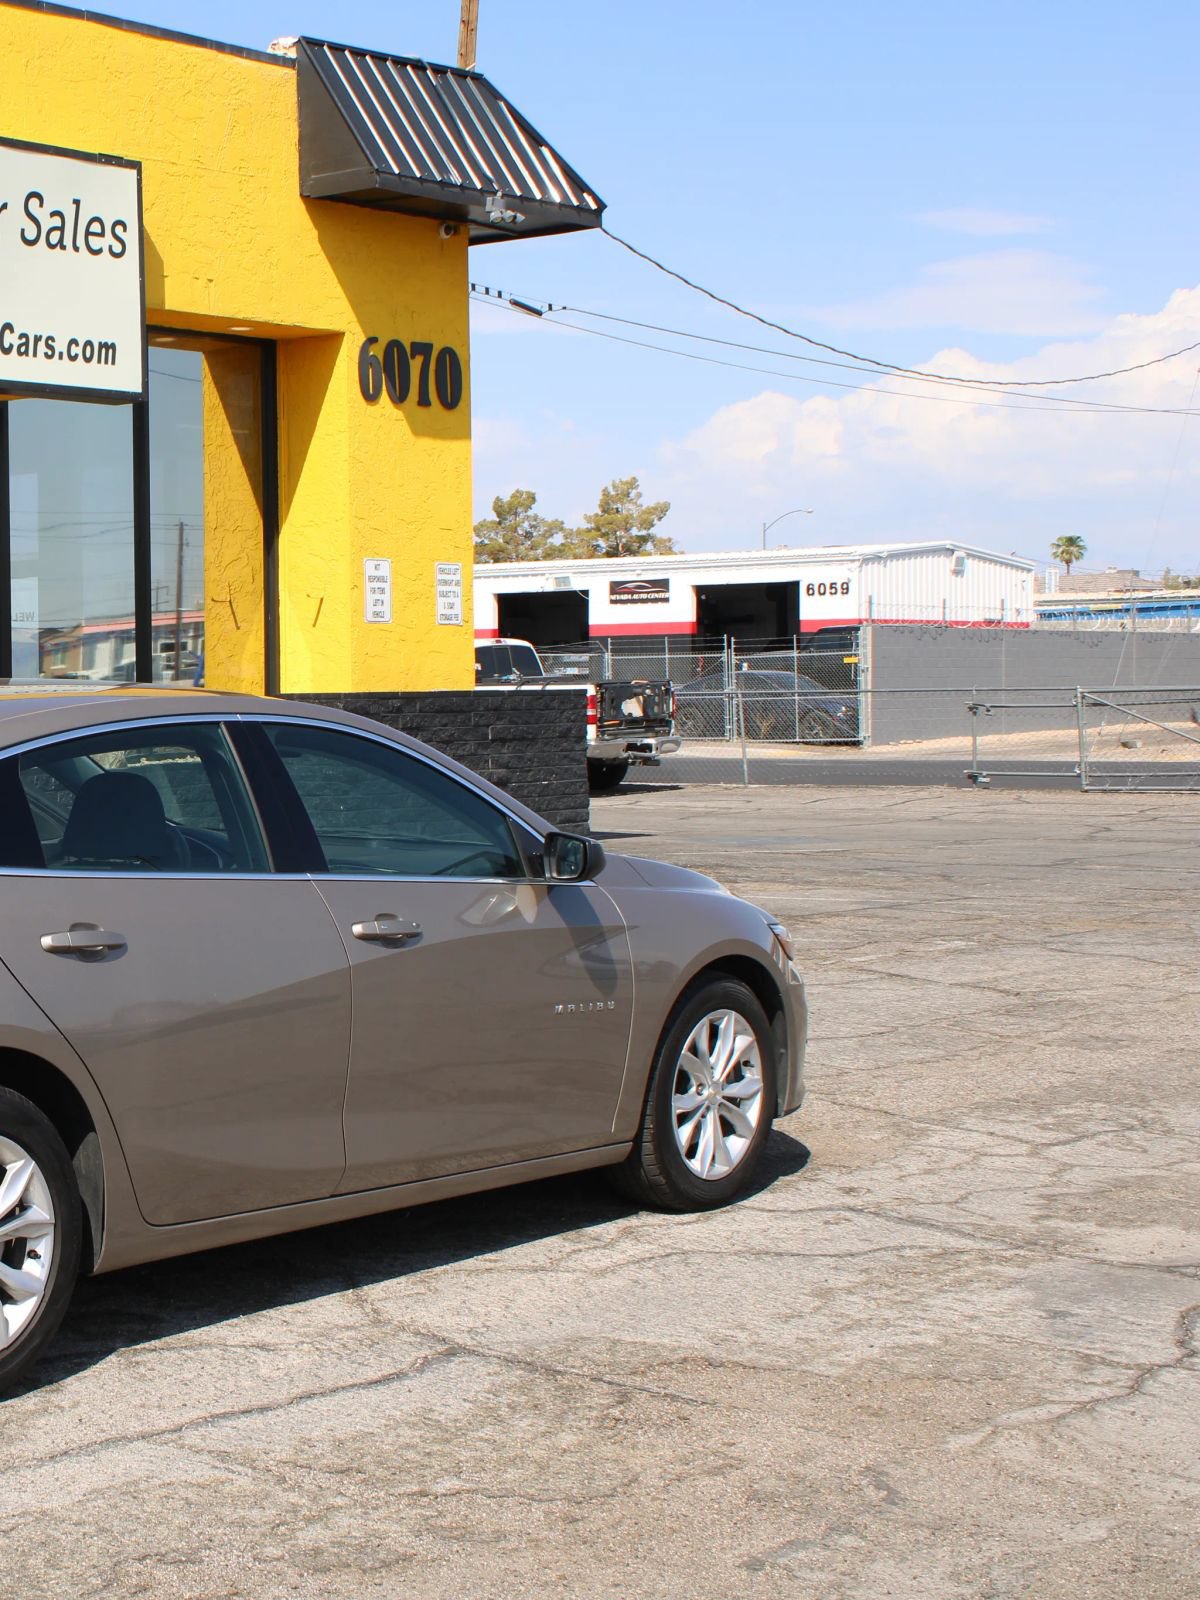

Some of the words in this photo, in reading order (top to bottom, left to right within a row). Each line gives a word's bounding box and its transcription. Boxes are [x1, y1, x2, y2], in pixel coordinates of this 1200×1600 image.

[19, 192, 129, 260] Sales
[358, 336, 462, 410] 6070
[806, 582, 850, 596] 6059
